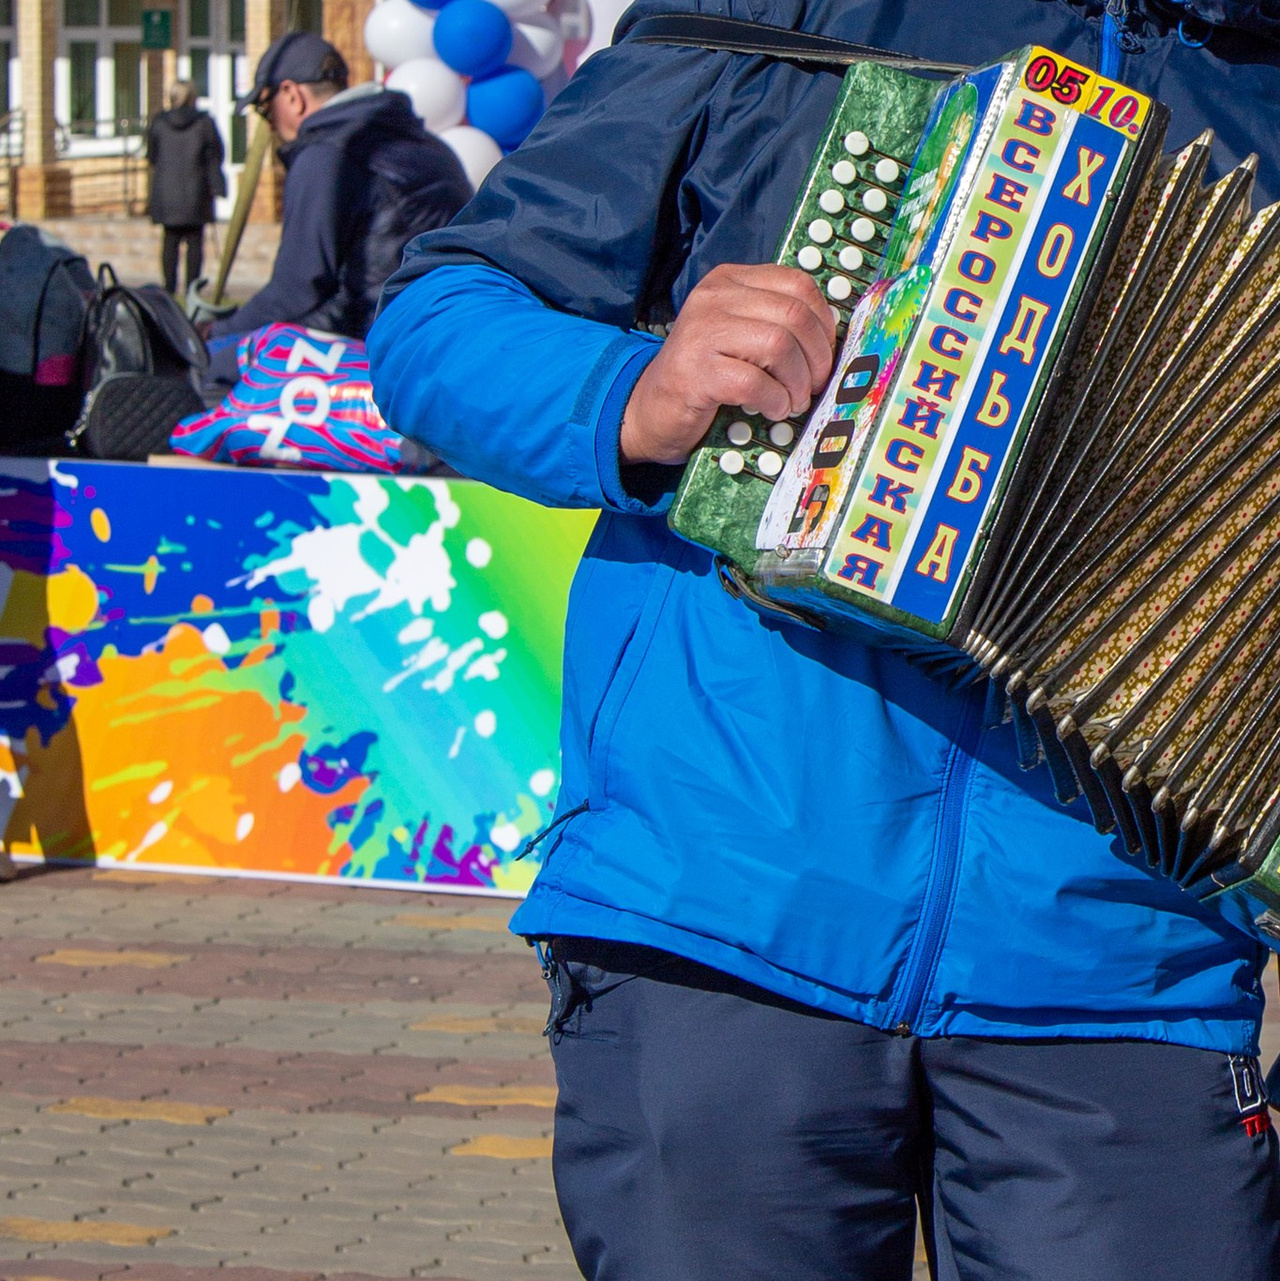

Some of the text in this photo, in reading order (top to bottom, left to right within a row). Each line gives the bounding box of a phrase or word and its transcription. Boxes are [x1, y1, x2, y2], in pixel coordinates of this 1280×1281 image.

[1025, 55, 1090, 104] 05
[838, 98, 1057, 591] ВСЕРОССИЙСКАЯ
[915, 146, 1104, 584] ХОДЬБА
